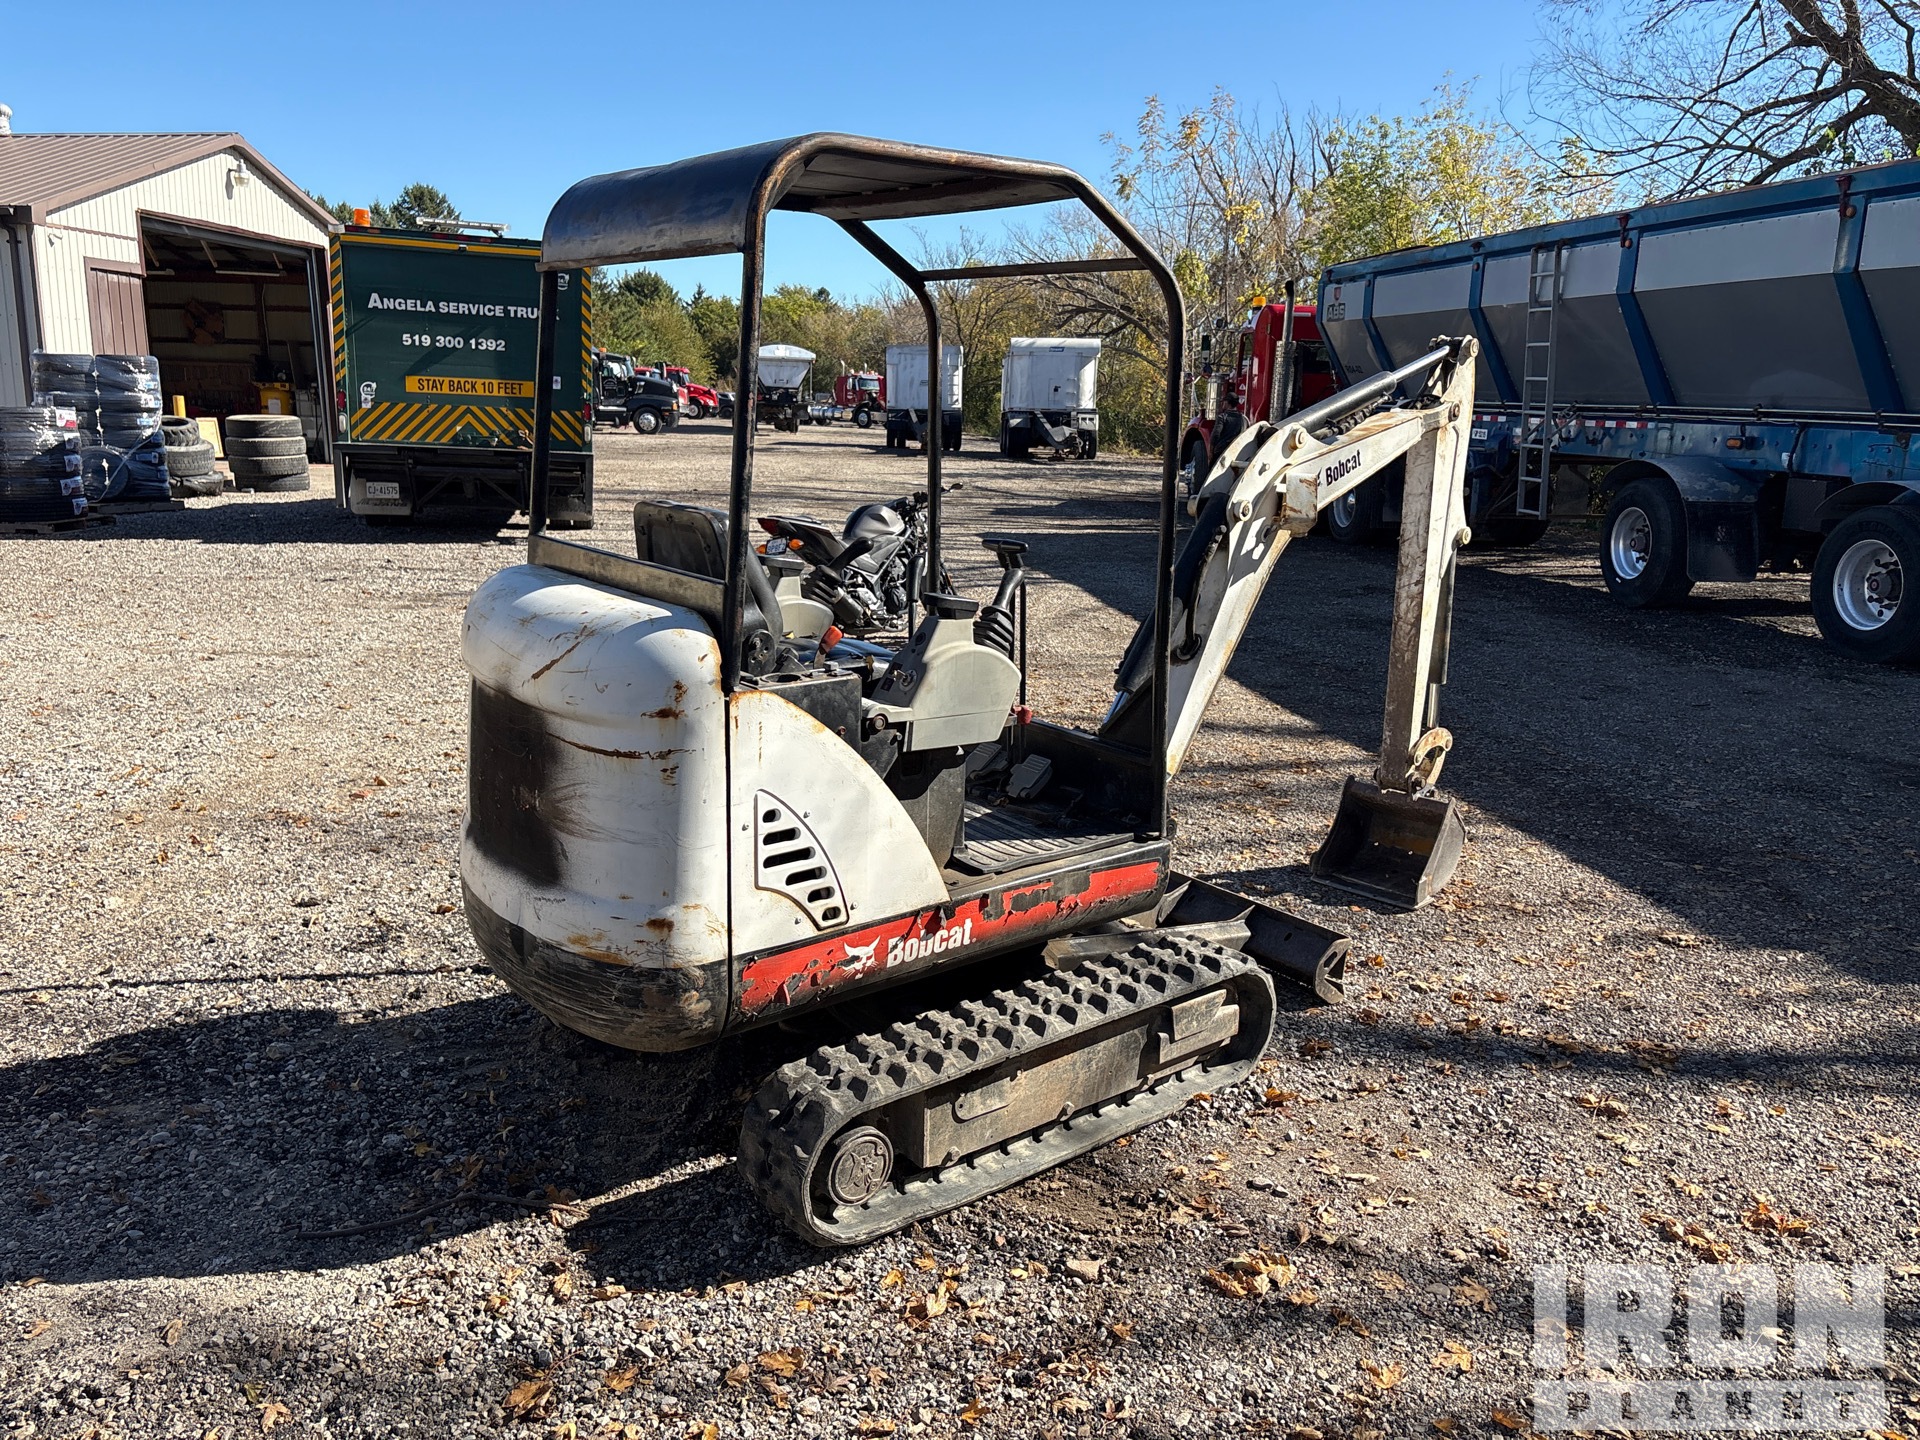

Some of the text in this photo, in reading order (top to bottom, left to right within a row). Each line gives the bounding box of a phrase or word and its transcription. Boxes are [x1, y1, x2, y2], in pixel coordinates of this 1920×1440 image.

[368, 292, 560, 320] ANGELA SERVICE TRU
[1328, 304, 1345, 320] ABS
[402, 333, 506, 351] 519 300 1392
[417, 378, 524, 395] STAY BACK 10 FEET
[1325, 449, 1362, 487] Bobcat
[886, 918, 973, 968] Bobcat
